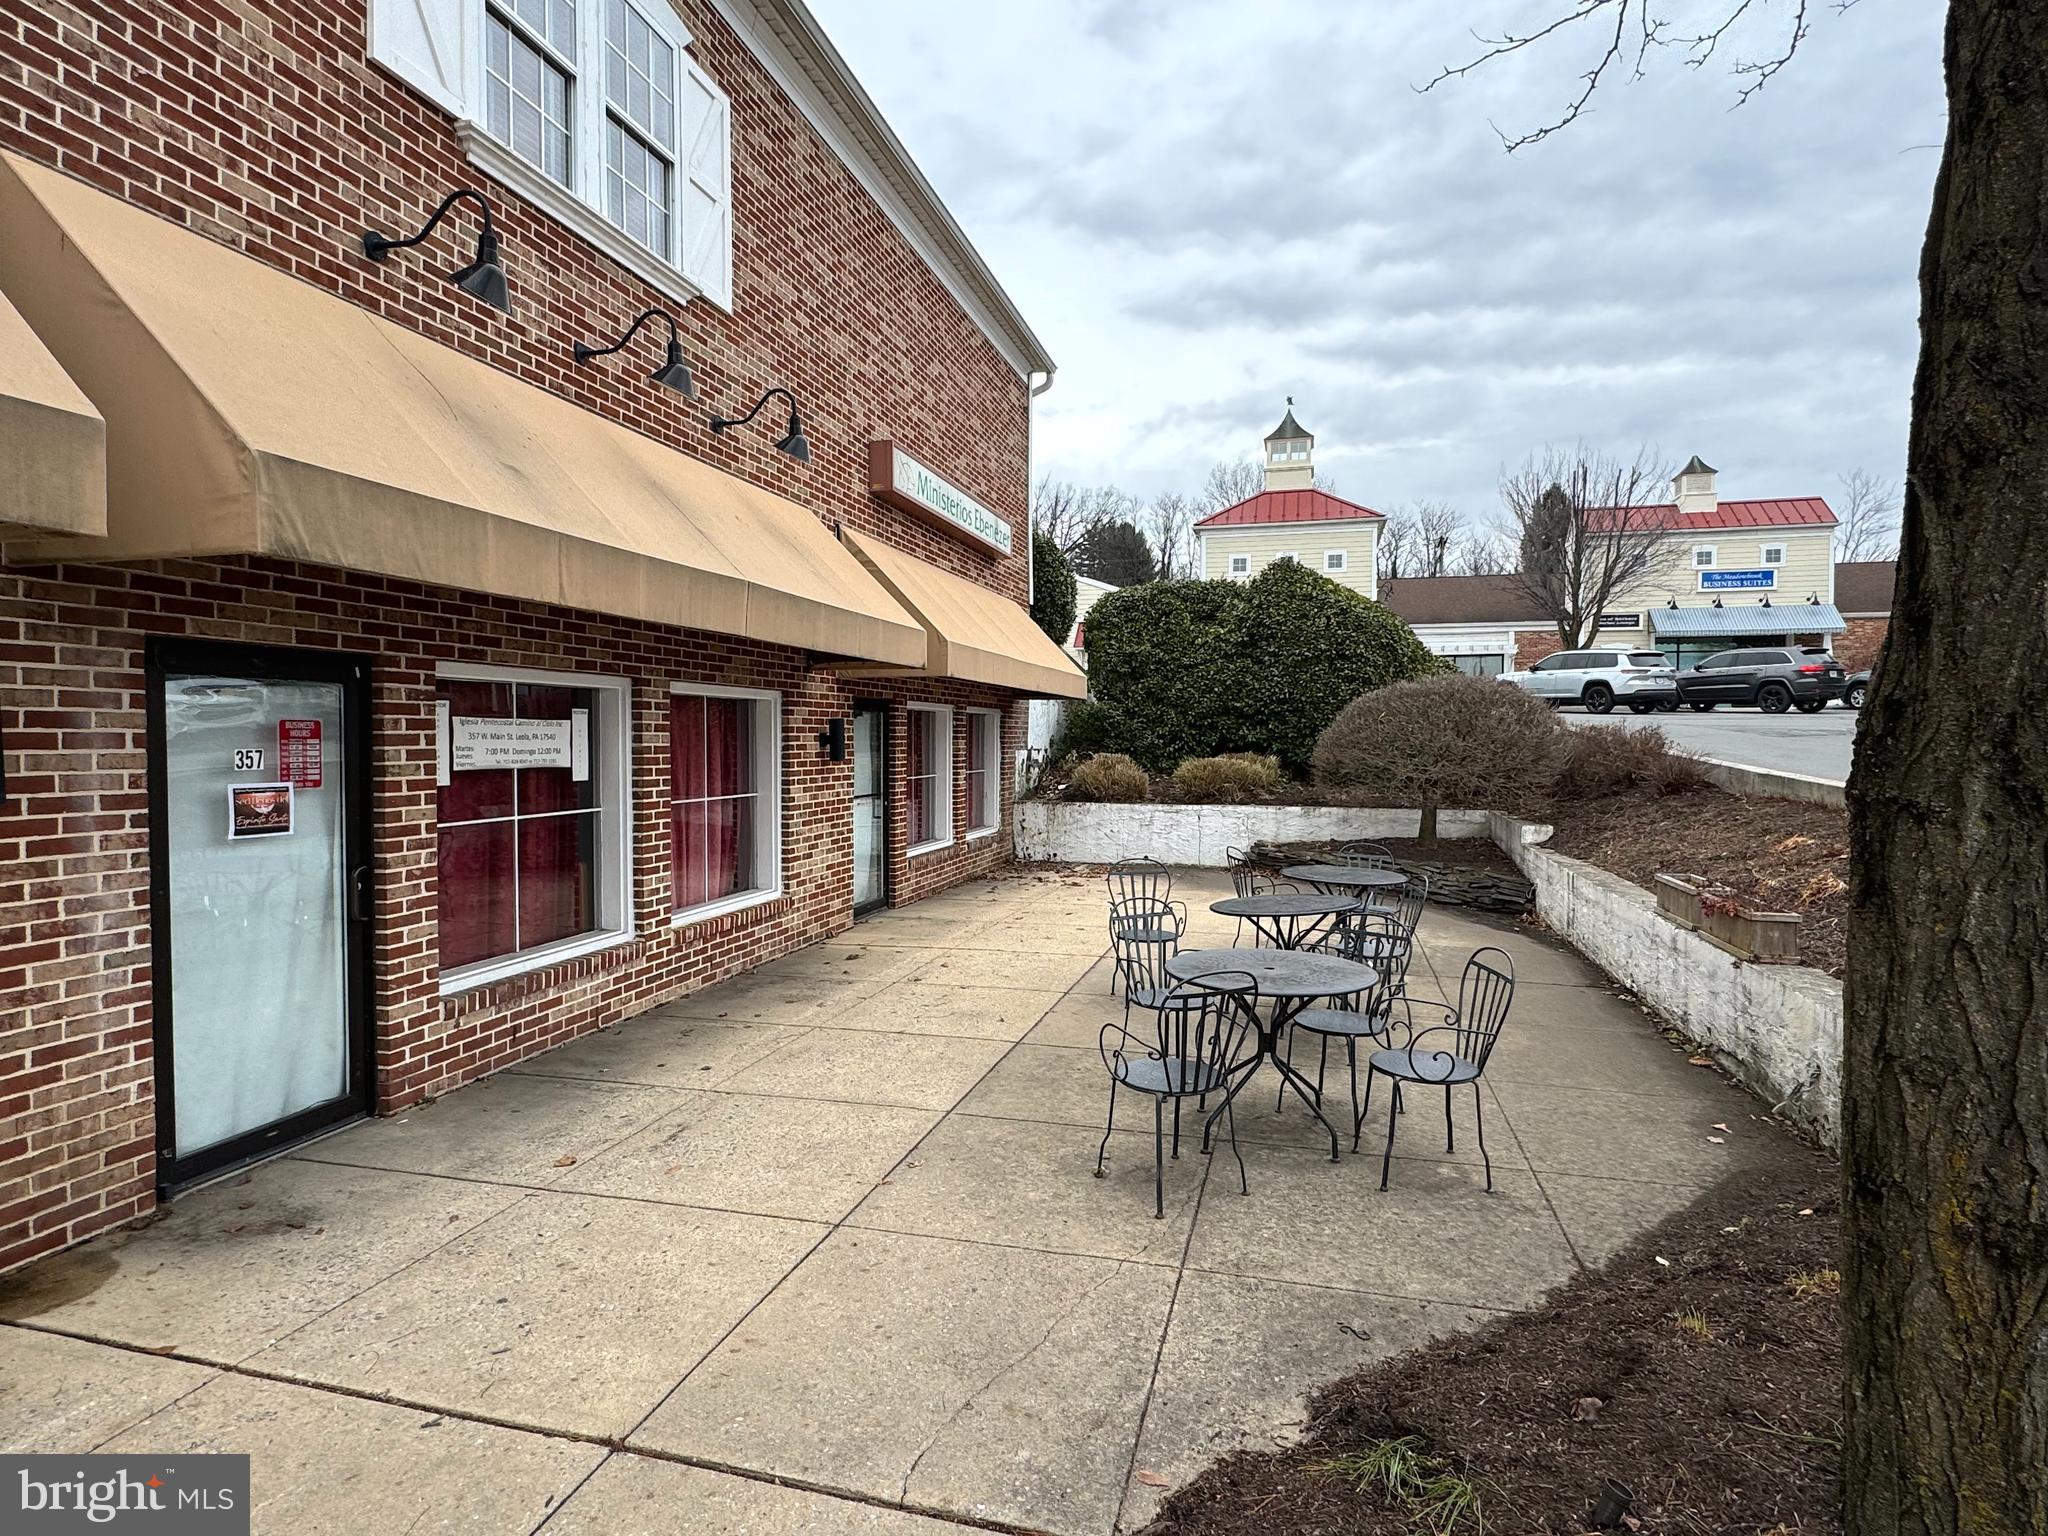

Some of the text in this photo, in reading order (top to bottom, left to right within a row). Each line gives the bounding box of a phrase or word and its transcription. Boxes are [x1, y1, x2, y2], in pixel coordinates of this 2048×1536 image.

[917, 471, 1010, 548] Ministerios Ebenezer
[1703, 579, 1772, 588] BUSINESS SUITES
[285, 721, 315, 729] BUSINESS
[459, 718, 479, 727] Iglesia
[289, 729, 311, 737] HOURS
[468, 732, 480, 740] 357
[490, 732, 506, 740] Main
[540, 733, 556, 741] 17540
[499, 747, 510, 755] PM
[552, 747, 561, 755] PM
[236, 750, 263, 769] 357
